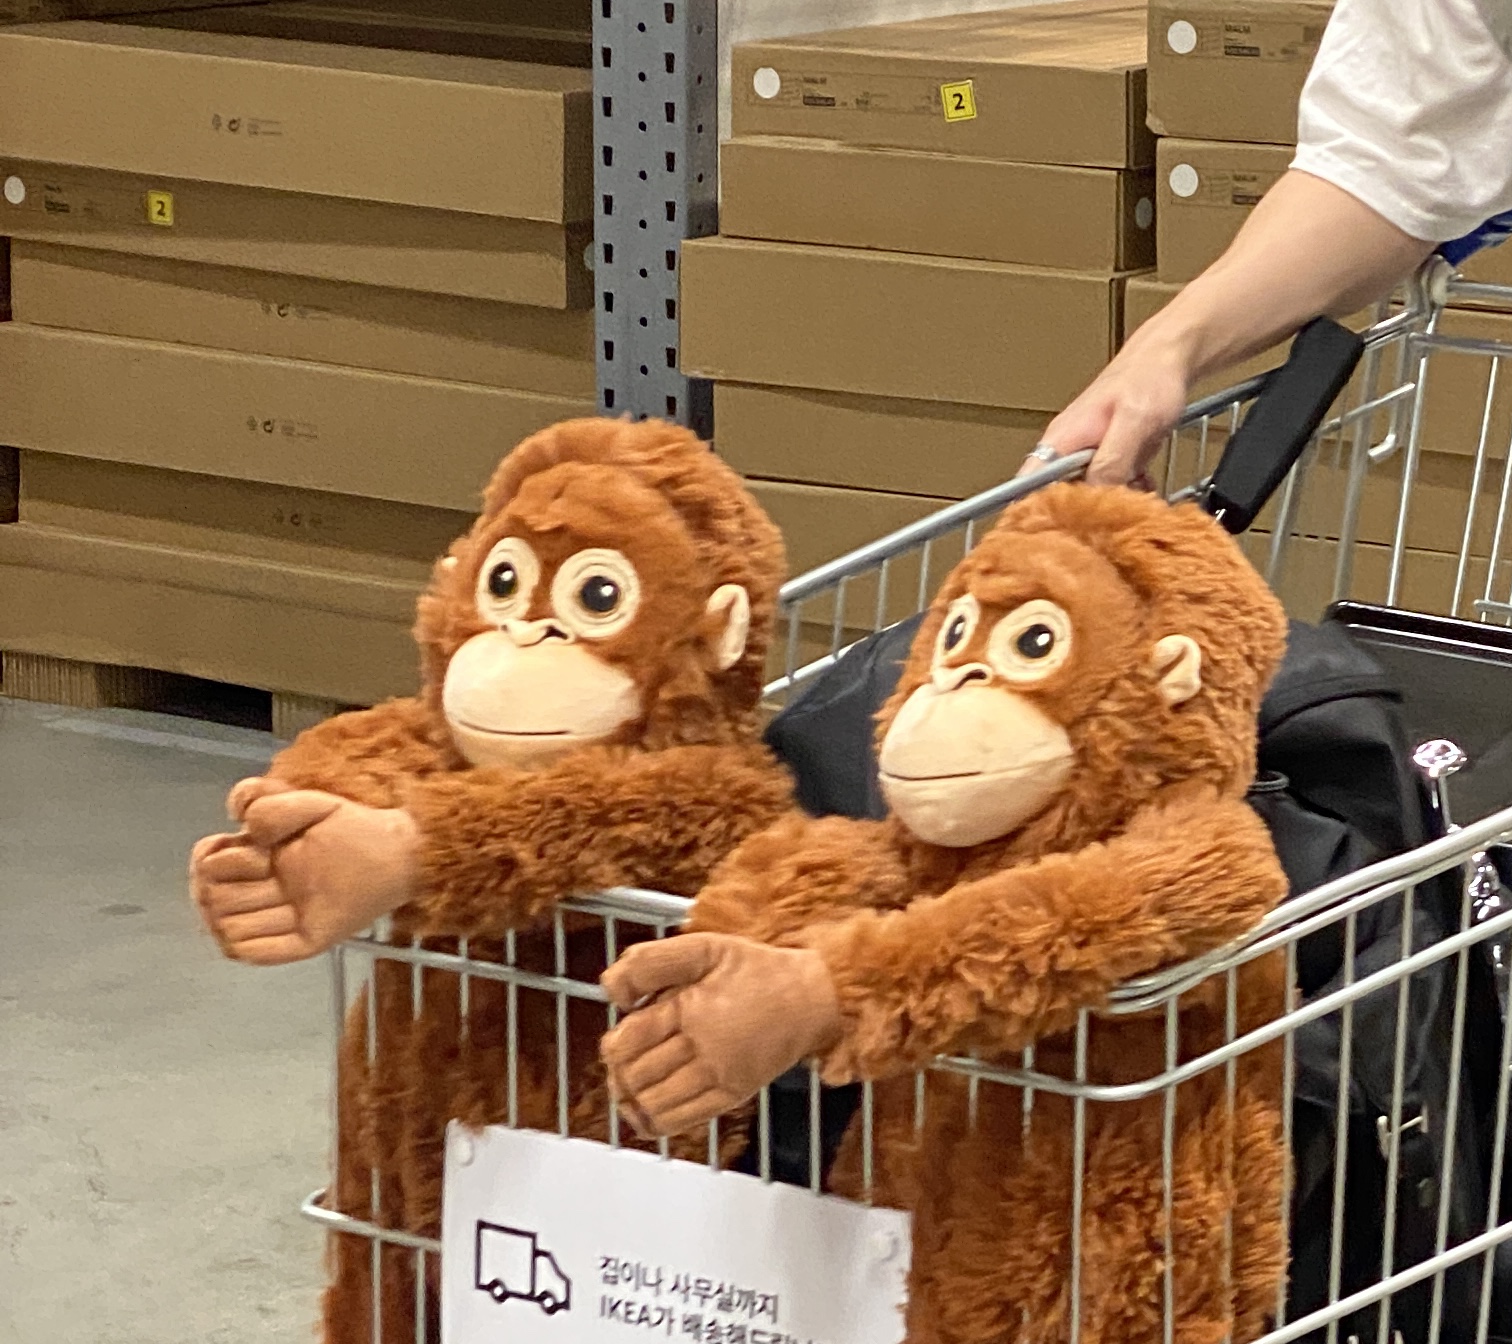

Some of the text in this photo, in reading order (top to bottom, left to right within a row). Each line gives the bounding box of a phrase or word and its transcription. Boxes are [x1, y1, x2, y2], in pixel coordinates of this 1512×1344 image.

[952, 93, 965, 110] 2
[157, 200, 166, 217] 2
[600, 1256, 779, 1324] 집이나 사무실까지
[600, 1294, 675, 1336] IKEA가
